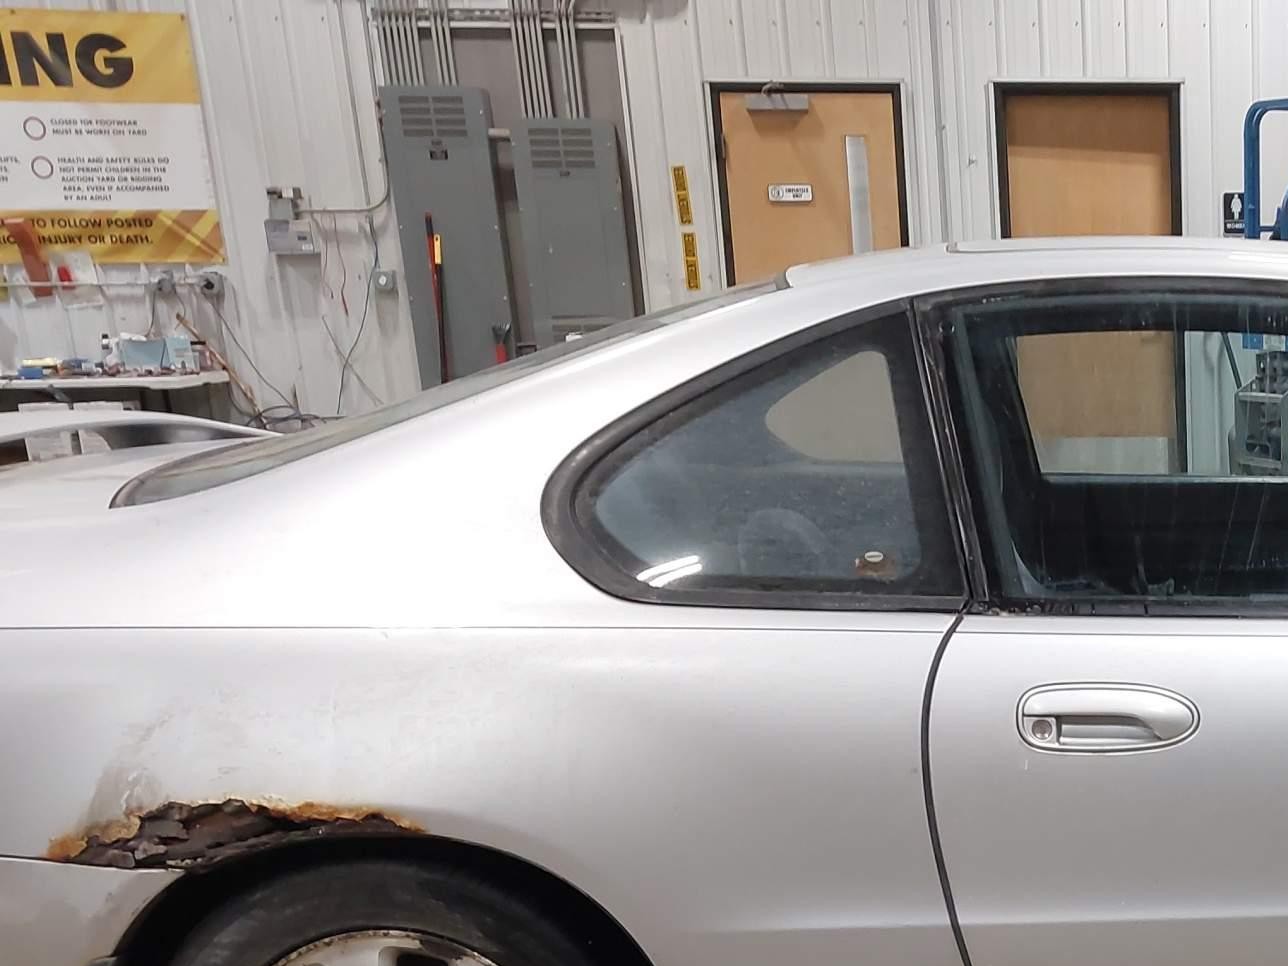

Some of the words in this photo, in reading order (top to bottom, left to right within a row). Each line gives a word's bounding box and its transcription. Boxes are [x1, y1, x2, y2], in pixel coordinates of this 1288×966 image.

[51, 217, 102, 229] FOLLOW
[107, 217, 153, 229] POSTED
[38, 234, 82, 245] INJURY
[87, 234, 106, 245] OR
